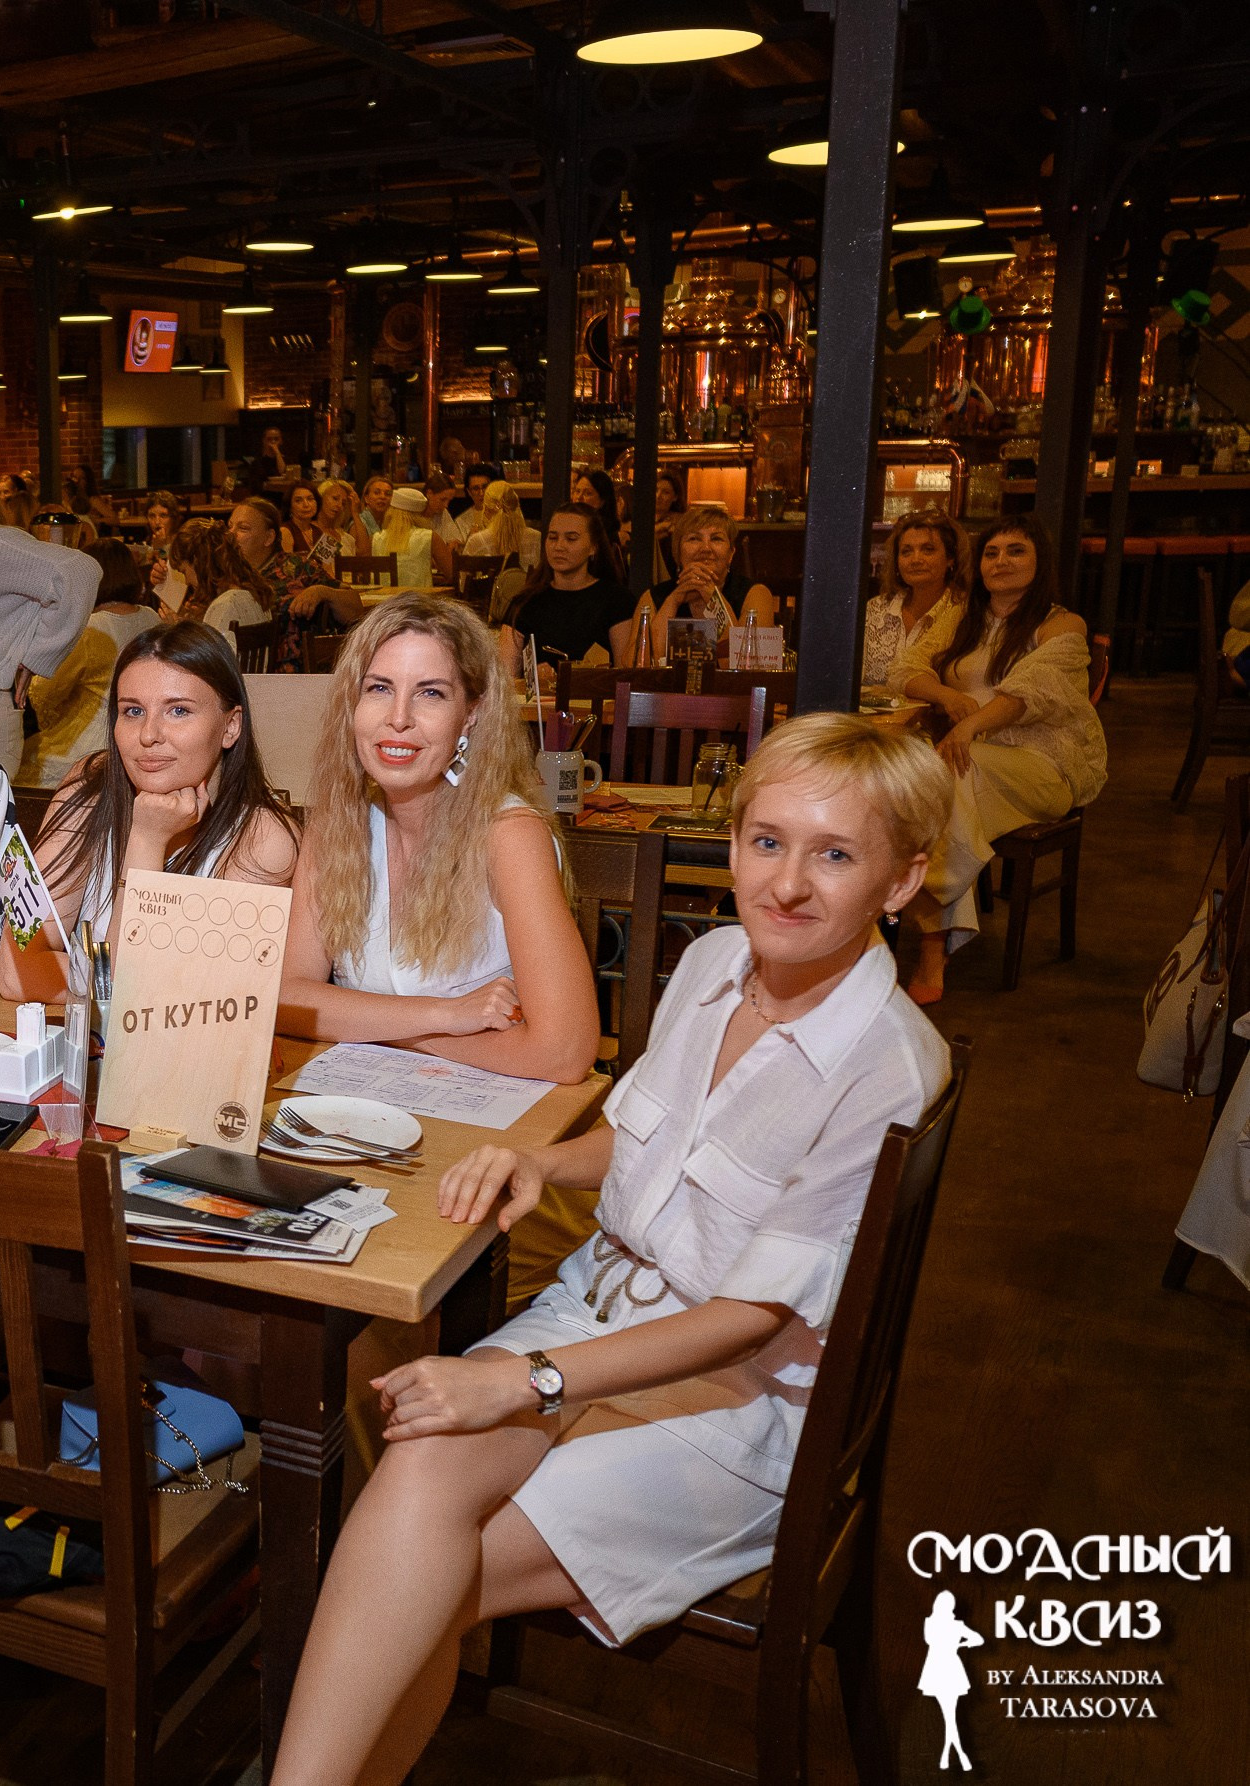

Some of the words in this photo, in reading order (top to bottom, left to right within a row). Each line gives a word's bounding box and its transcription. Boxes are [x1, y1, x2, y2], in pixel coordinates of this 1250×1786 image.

[11, 877, 40, 930] 511
[138, 902, 168, 917] КВИЗ
[122, 1007, 154, 1034] ОТ
[164, 995, 259, 1029] КУТЮР
